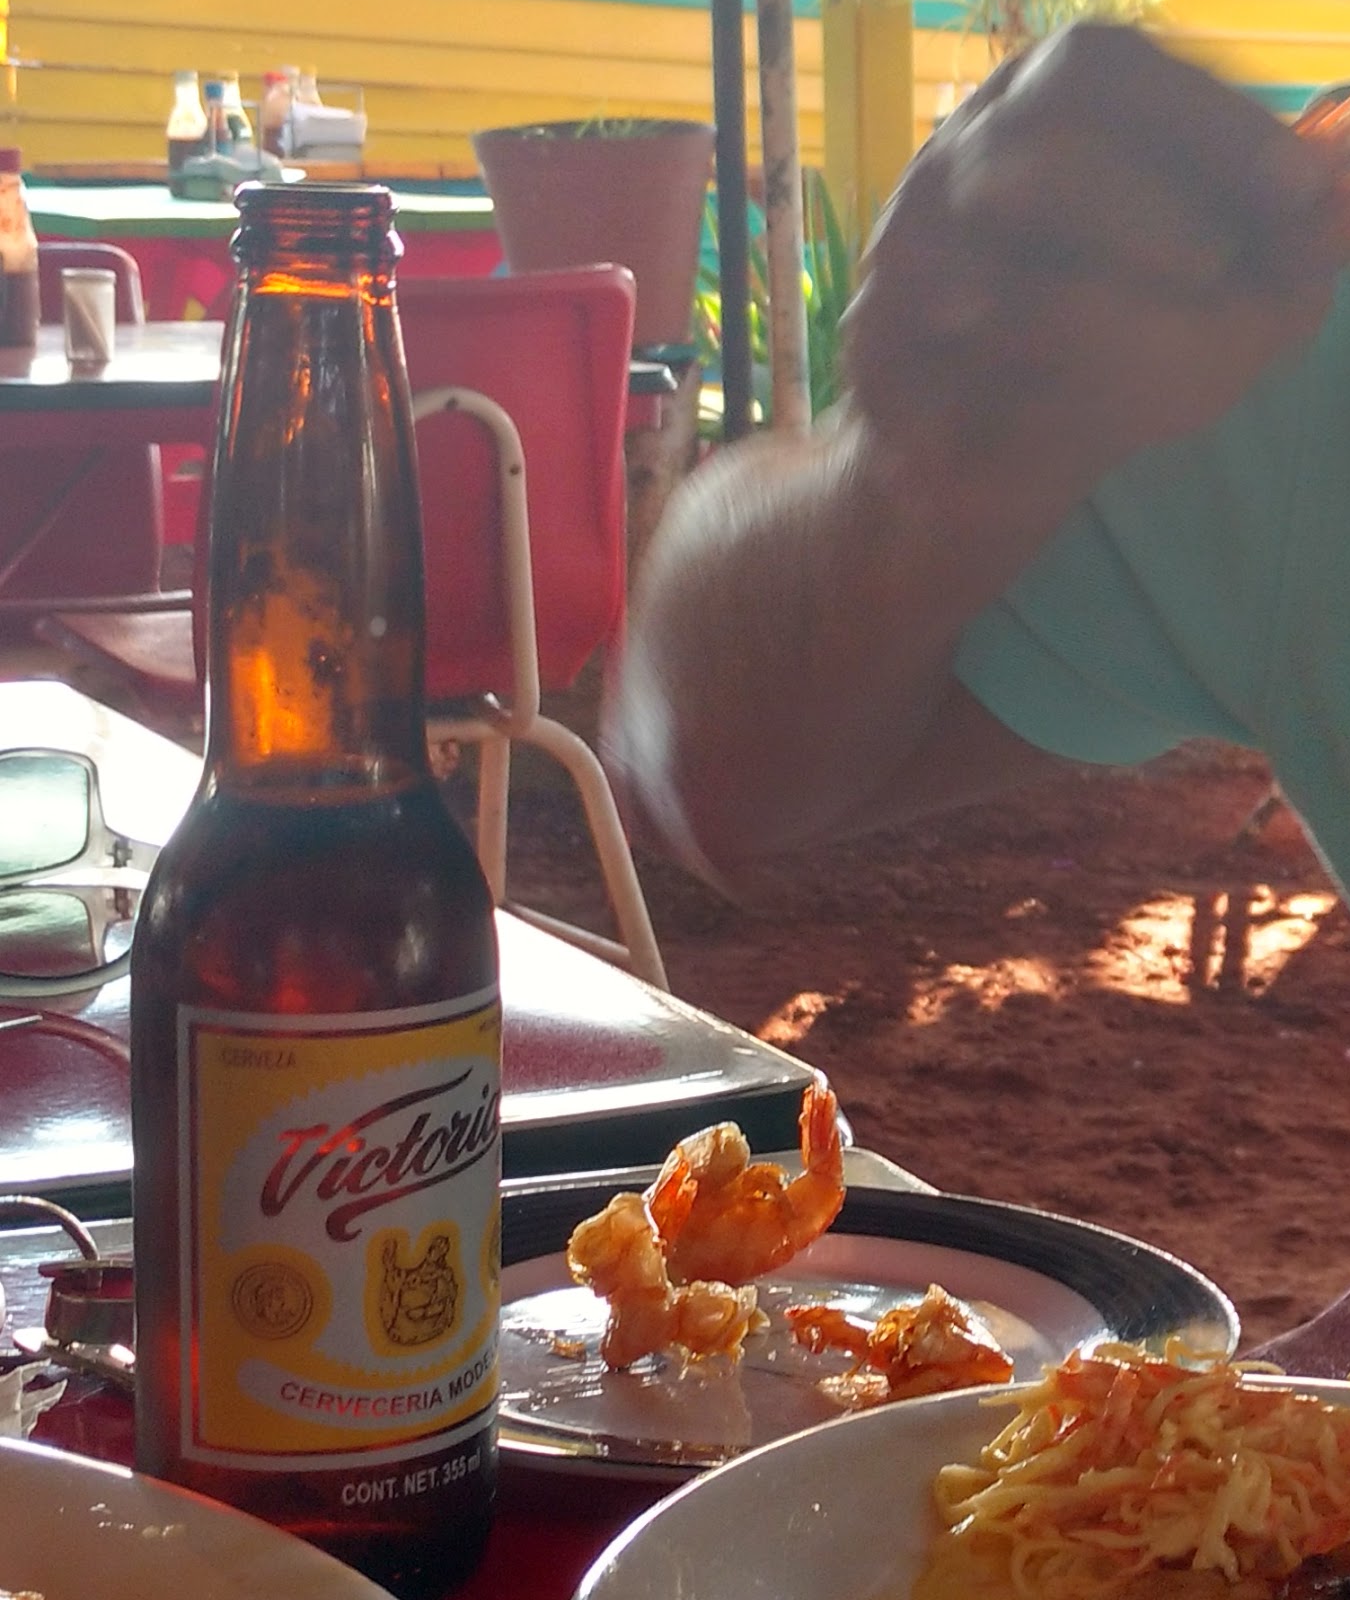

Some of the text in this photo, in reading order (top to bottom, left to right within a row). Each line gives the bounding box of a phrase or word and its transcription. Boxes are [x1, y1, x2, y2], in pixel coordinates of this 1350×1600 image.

[221, 1046, 297, 1069] CERVEZA
[280, 1380, 443, 1419] CERVECERIA
[341, 1446, 481, 1506] CONT. NET. 355 ml
